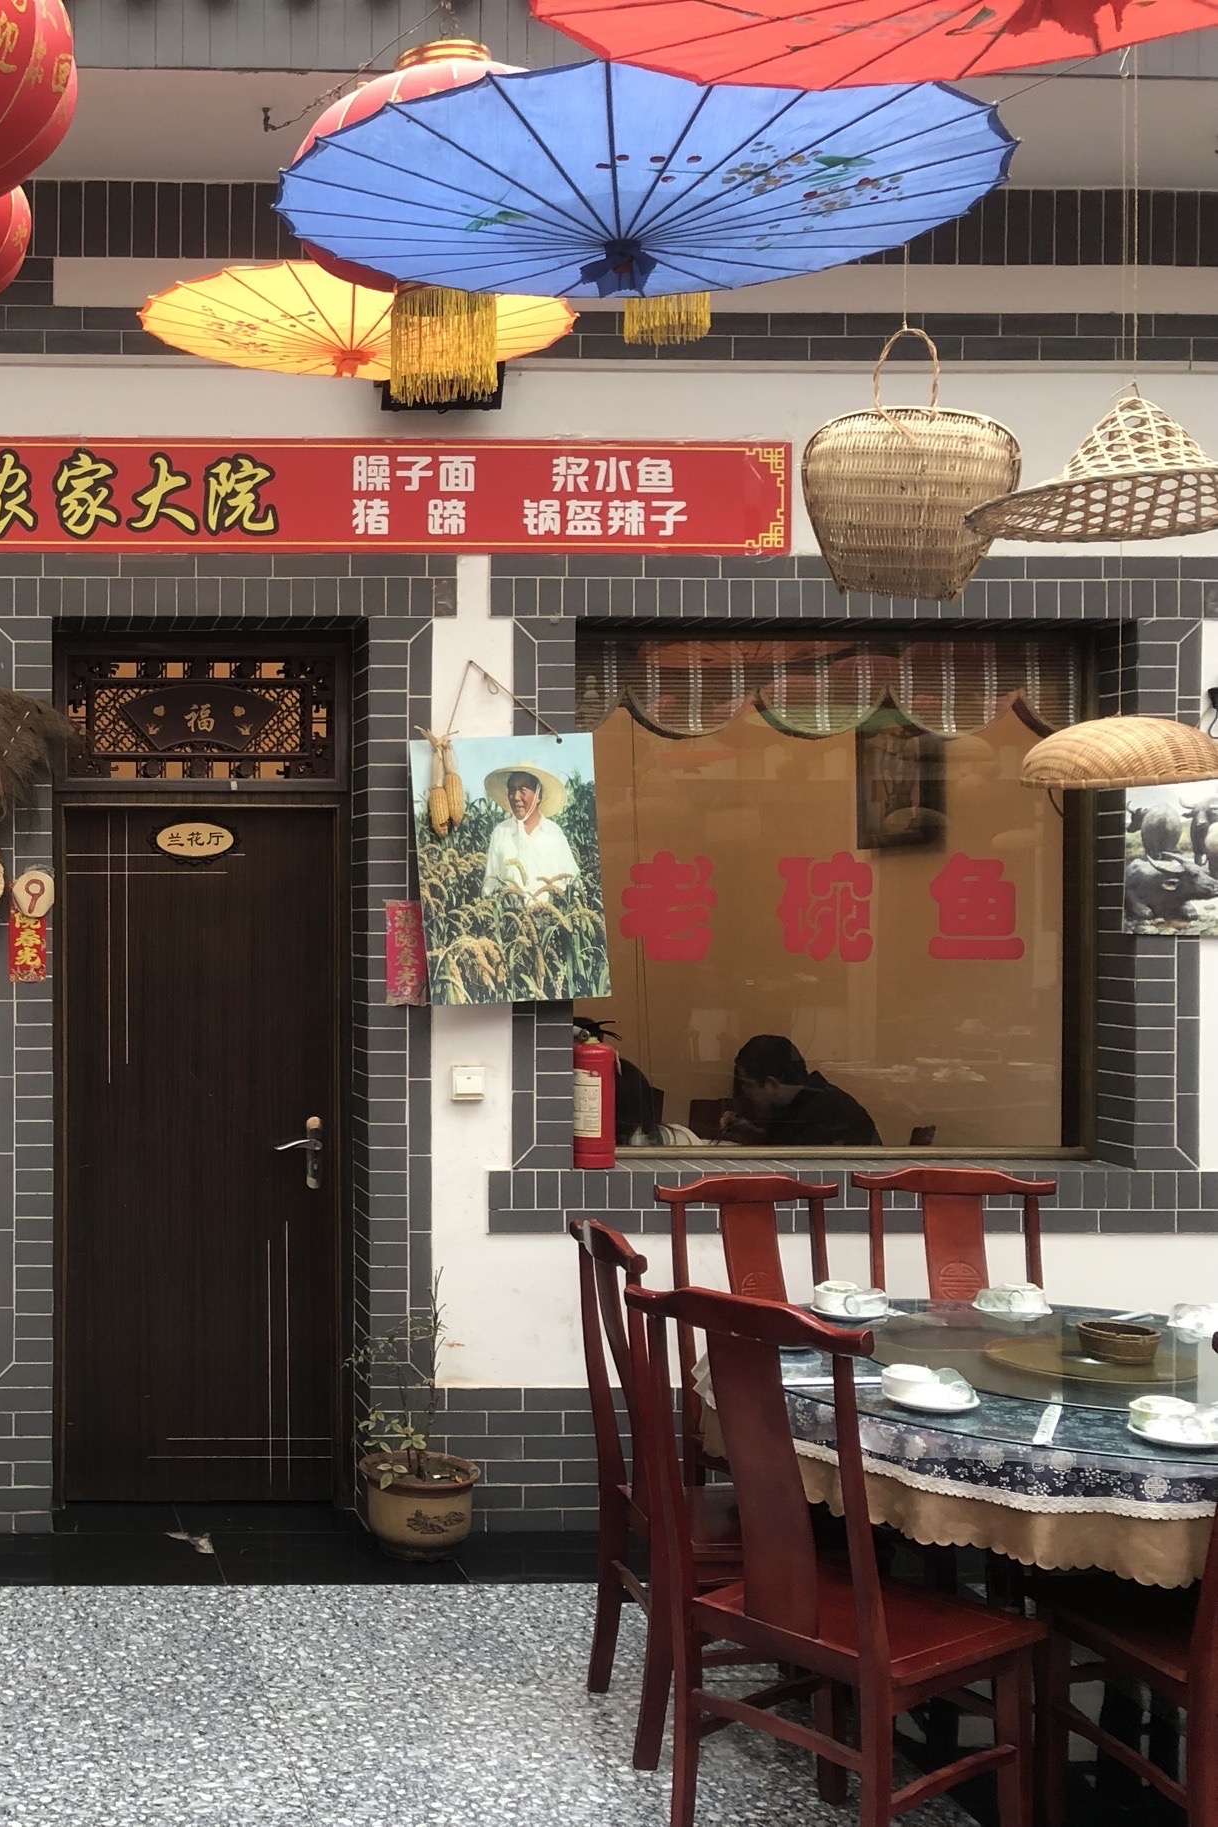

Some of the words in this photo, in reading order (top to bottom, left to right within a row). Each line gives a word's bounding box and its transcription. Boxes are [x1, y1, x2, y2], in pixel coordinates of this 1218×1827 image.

[352, 455, 477, 492] 臊子面
[551, 456, 675, 494] 浆水鱼
[523, 499, 688, 536] 锅盔辣子
[184, 703, 215, 733] 福
[167, 831, 224, 847] 兰花厅
[620, 851, 1025, 962] 老碗鱼
[13, 912, 42, 966] 院春光
